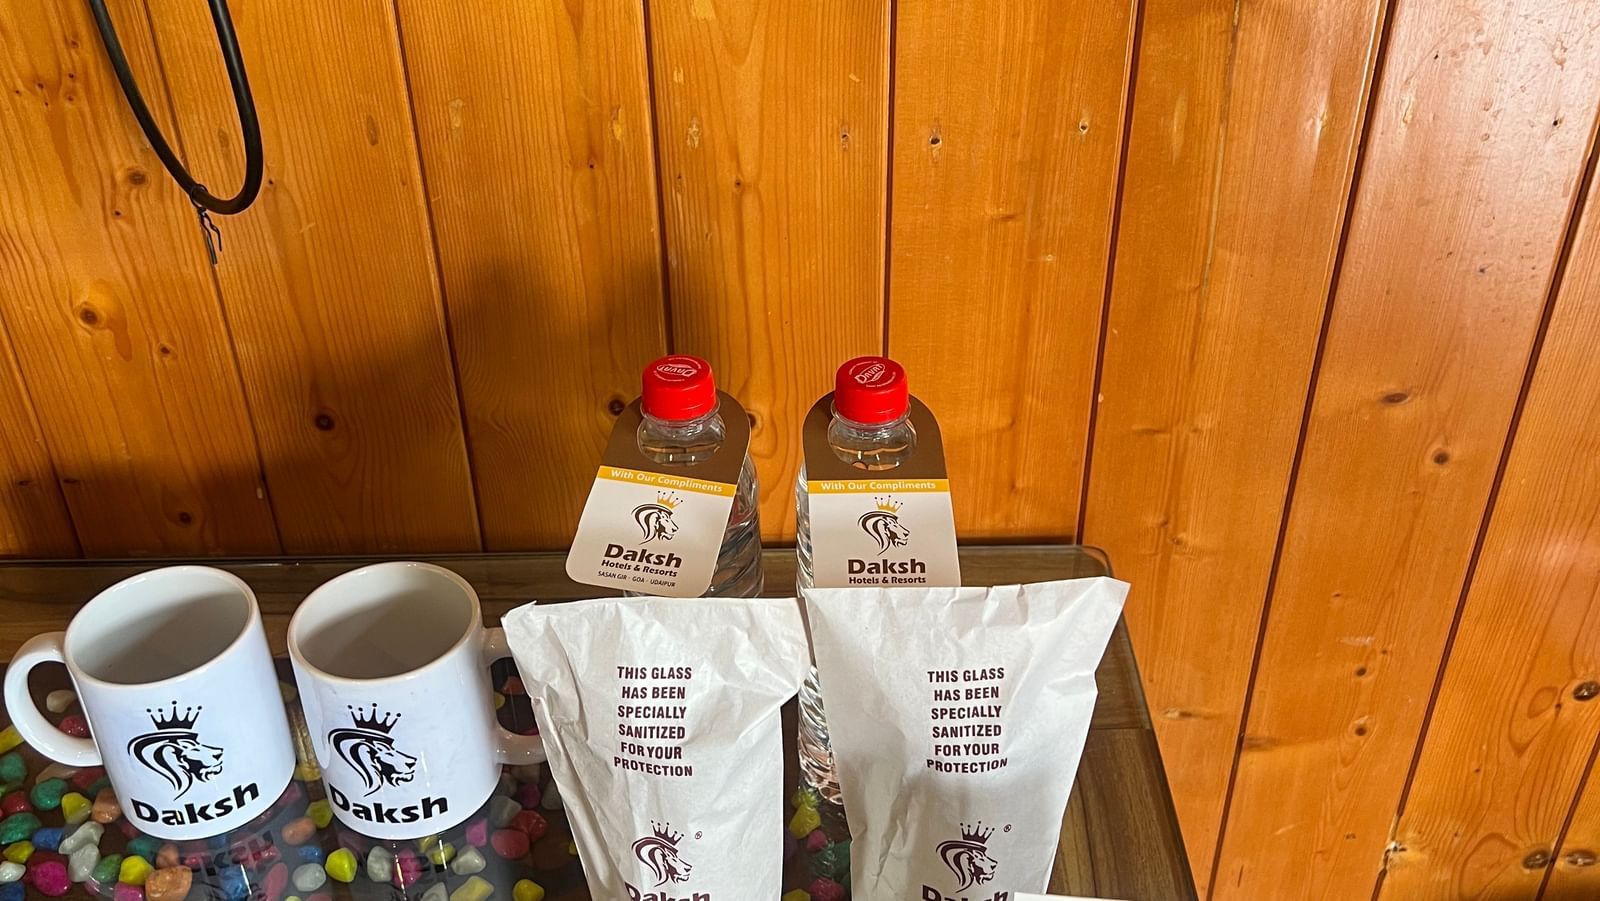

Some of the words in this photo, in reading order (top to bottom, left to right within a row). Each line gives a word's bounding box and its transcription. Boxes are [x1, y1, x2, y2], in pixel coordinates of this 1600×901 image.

[611, 468, 634, 479] With
[637, 472, 655, 483] Our
[657, 477, 723, 493] Compliments
[848, 482, 867, 490] Our
[869, 481, 936, 490] Compliments
[604, 543, 682, 568] Daksh
[601, 559, 631, 571] Hotels
[633, 564, 641, 572] &
[643, 566, 678, 577] Resorts
[848, 559, 925, 574] Daksh
[597, 571, 616, 579] SASAN
[650, 578, 676, 587] UDAIPUR
[617, 666, 647, 679] THIS
[652, 667, 692, 679] GLASS
[927, 671, 958, 682] THIS
[963, 667, 1004, 681] GLASS
[622, 686, 648, 699] HAS
[652, 687, 685, 699] BEEN
[934, 690, 960, 701] HAS
[965, 686, 999, 700] BEEN
[618, 705, 687, 719] SPECIALLY
[931, 705, 1002, 719] SPECIALLY
[619, 724, 685, 739] SANITIZED
[932, 725, 1002, 738] SANITIZED
[621, 742, 645, 757] FOR
[647, 746, 682, 759] YOUR
[935, 745, 961, 756] FOR
[963, 743, 999, 756] YOUR
[614, 757, 693, 776] PROTECTION
[926, 758, 1008, 773] PROTECTION
[131, 782, 260, 826] Daksh
[328, 783, 449, 824] Daksh
